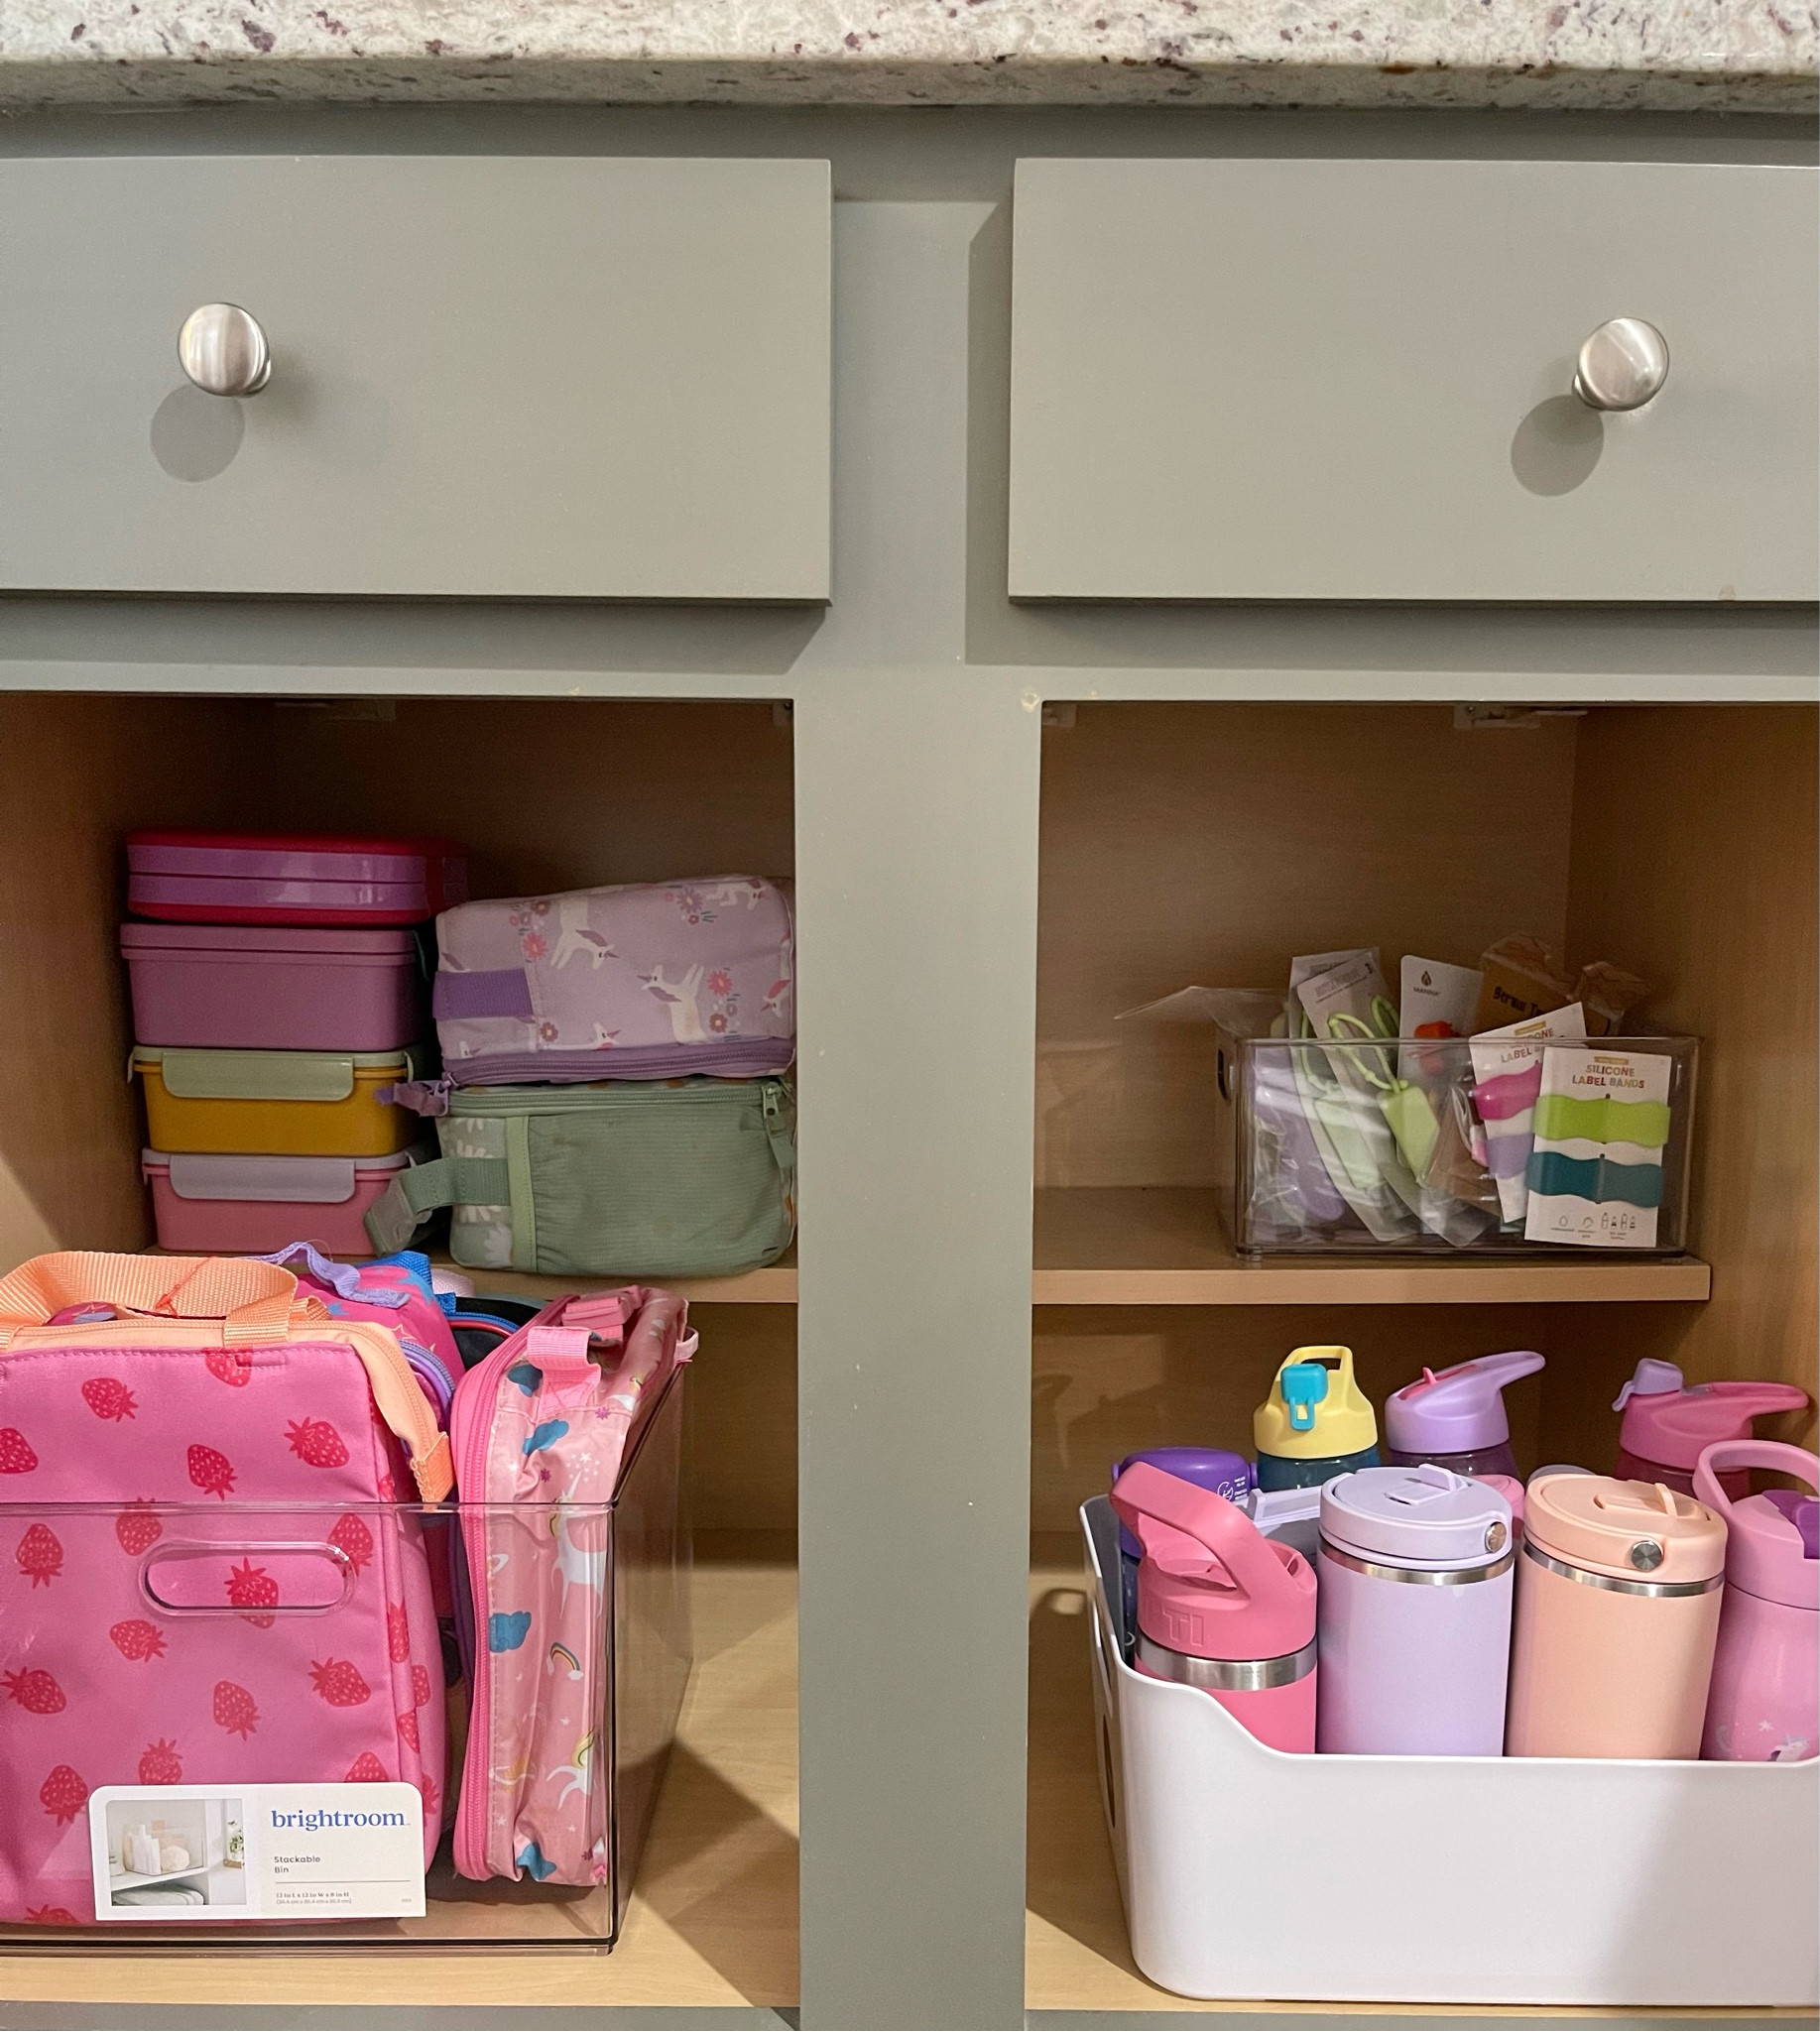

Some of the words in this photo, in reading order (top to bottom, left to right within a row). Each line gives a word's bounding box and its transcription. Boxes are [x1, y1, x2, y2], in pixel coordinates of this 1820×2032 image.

[1493, 986, 1527, 1012] Straw
[1501, 1046, 1532, 1064] LABEL
[1586, 1064, 1635, 1077] SILICONE
[1572, 1074, 1607, 1087] LABEL
[1609, 1077, 1645, 1089] BANDS
[271, 1810, 405, 1832] brightroom
[274, 1865, 290, 1874] Bin
